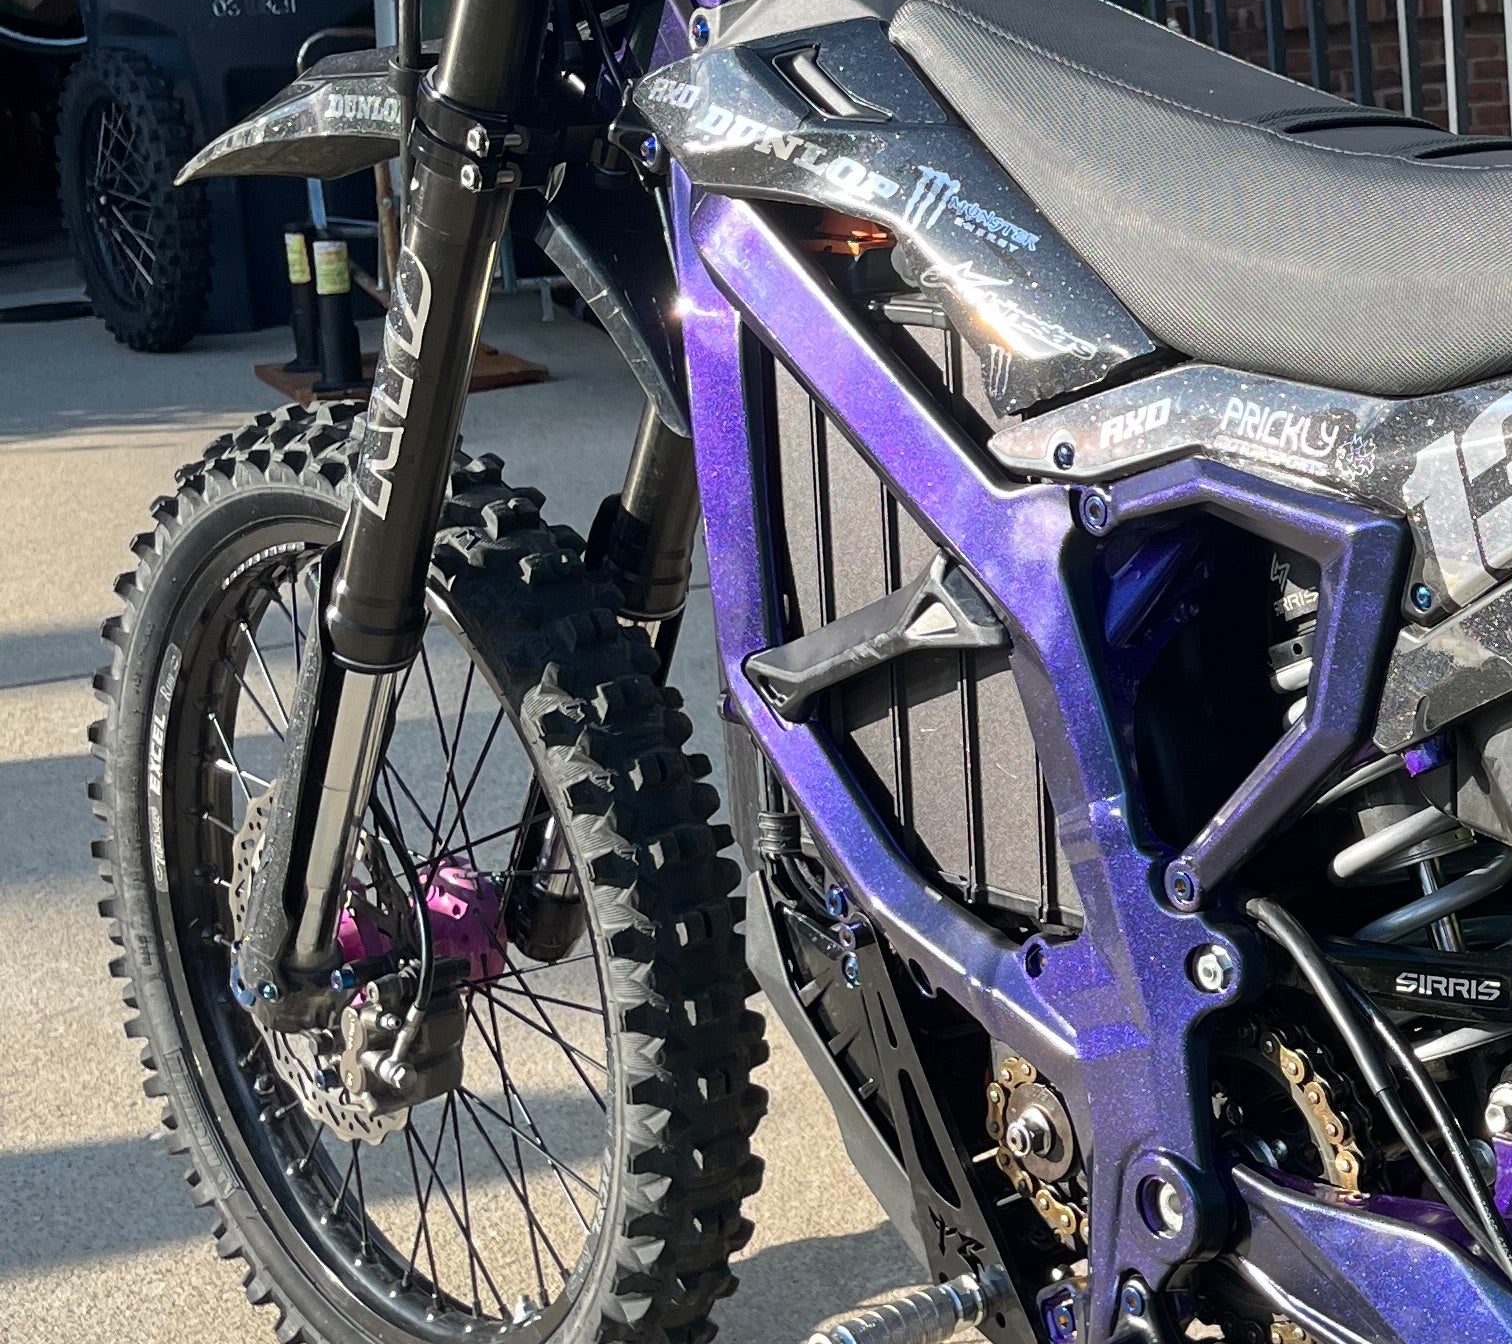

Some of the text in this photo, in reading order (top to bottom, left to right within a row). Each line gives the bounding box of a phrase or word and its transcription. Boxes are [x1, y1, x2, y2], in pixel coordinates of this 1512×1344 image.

[324, 93, 401, 124] DUNLO
[694, 104, 900, 203] DUNLOP
[948, 193, 1041, 252] MONSTER
[1220, 394, 1341, 457] PRICKLY
[150, 713, 168, 797] EXCEL
[1395, 971, 1501, 1002] SIRRIS
